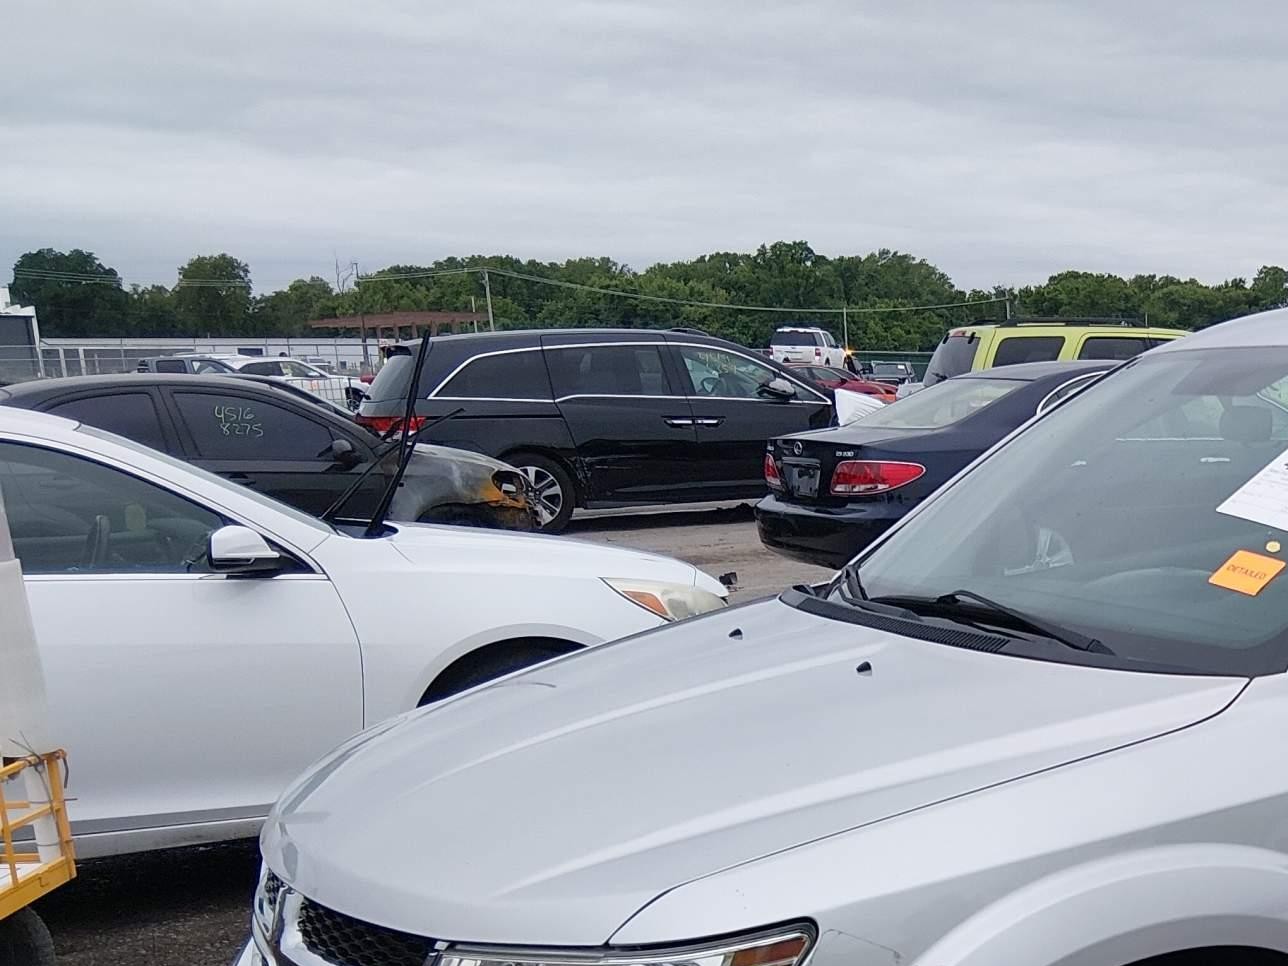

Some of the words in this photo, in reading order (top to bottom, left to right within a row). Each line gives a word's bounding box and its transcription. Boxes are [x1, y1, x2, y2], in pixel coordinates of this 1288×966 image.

[214, 405, 255, 424] 4516
[220, 423, 264, 437] 8275
[1226, 564, 1267, 580] DETAILED
